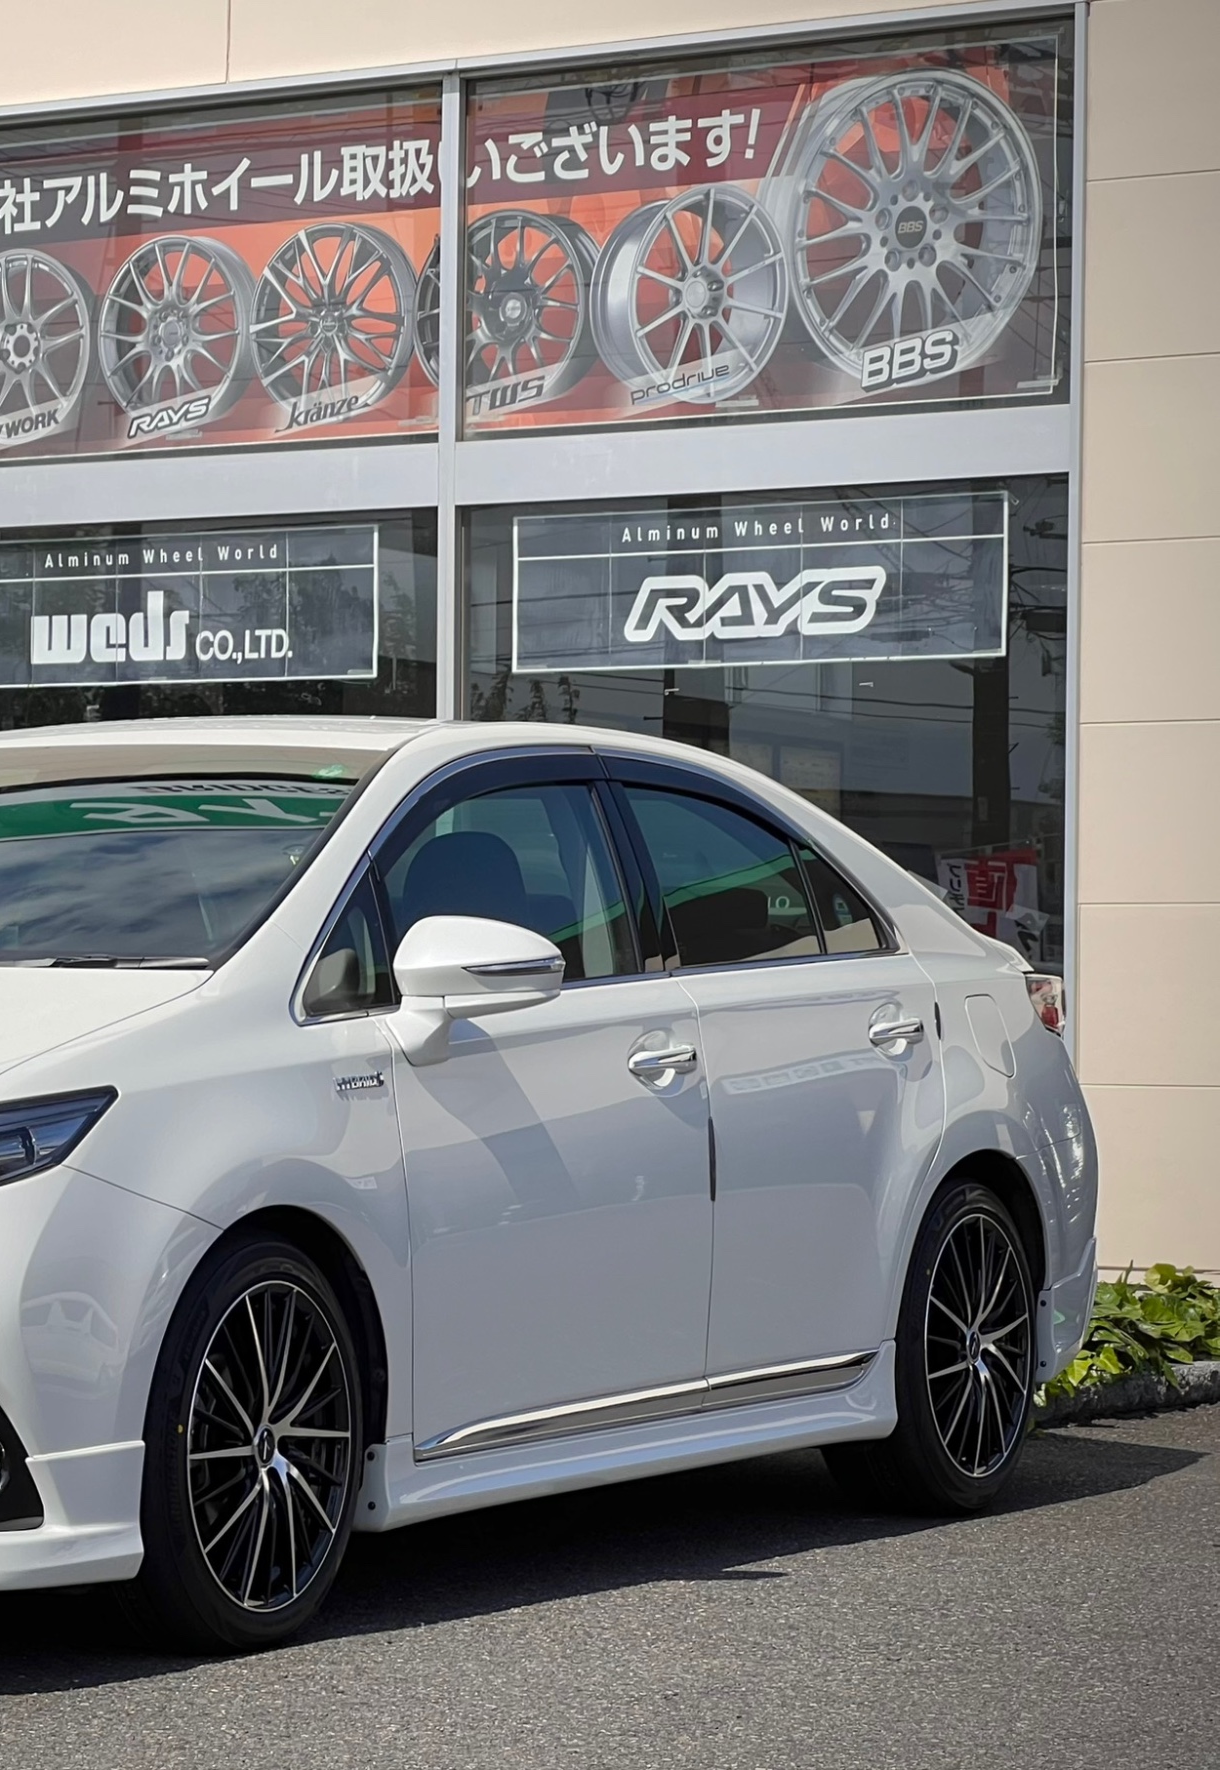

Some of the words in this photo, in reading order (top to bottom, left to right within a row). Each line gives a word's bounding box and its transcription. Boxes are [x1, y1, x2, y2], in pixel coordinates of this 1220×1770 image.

[897, 220, 924, 234] BBS
[861, 330, 961, 394] BBS
[466, 375, 546, 416] TWS
[631, 363, 730, 405] prodrive
[4, 408, 60, 438] WORK
[127, 394, 212, 440] RAYS
[621, 526, 720, 543] Alminum
[734, 517, 805, 537] Wheel
[821, 513, 890, 533] World
[44, 552, 130, 568] Alminum
[143, 547, 203, 564] Wheel
[218, 543, 278, 561] World
[624, 566, 887, 642] RAYS
